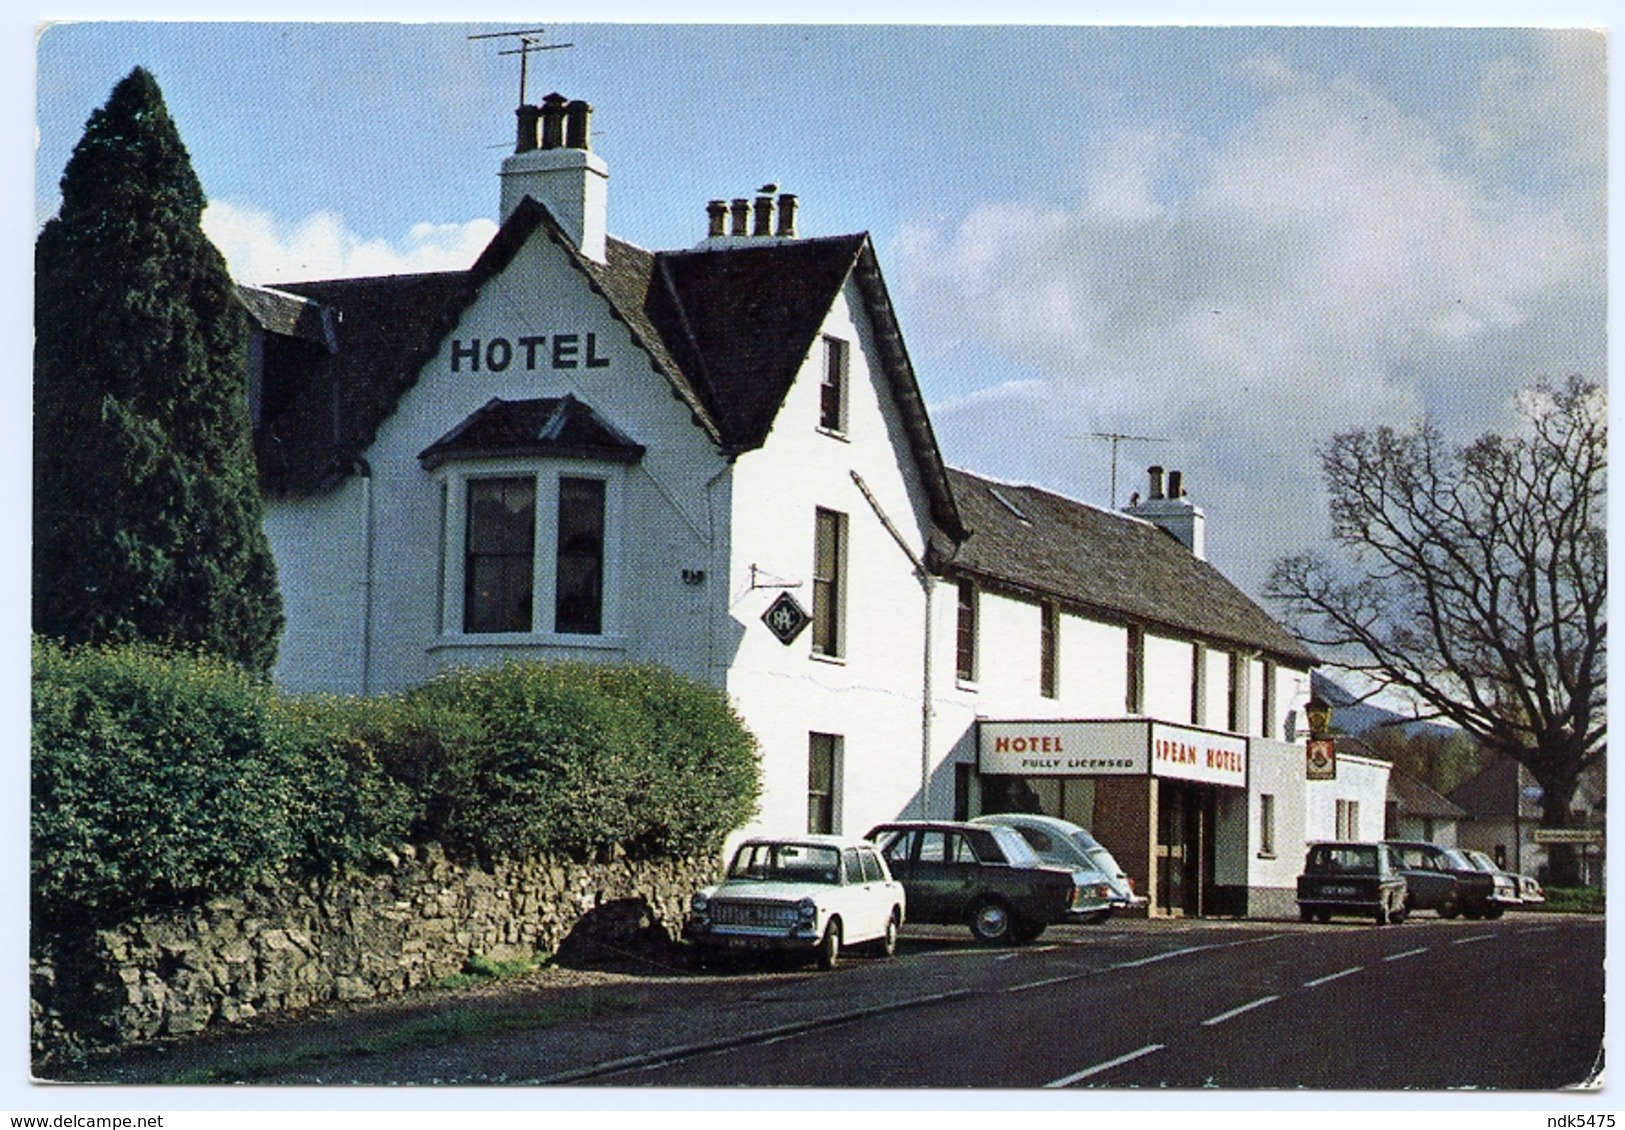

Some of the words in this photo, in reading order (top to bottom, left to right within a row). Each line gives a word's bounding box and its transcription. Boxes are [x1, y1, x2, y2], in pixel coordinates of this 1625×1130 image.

[451, 332, 610, 373] HOTEL
[995, 736, 1064, 753] HOTEL
[1155, 739, 1197, 765] SPEAN
[1206, 747, 1243, 773] HOTEL
[1022, 759, 1061, 768] FULLY
[1068, 759, 1134, 769] LICENSED
